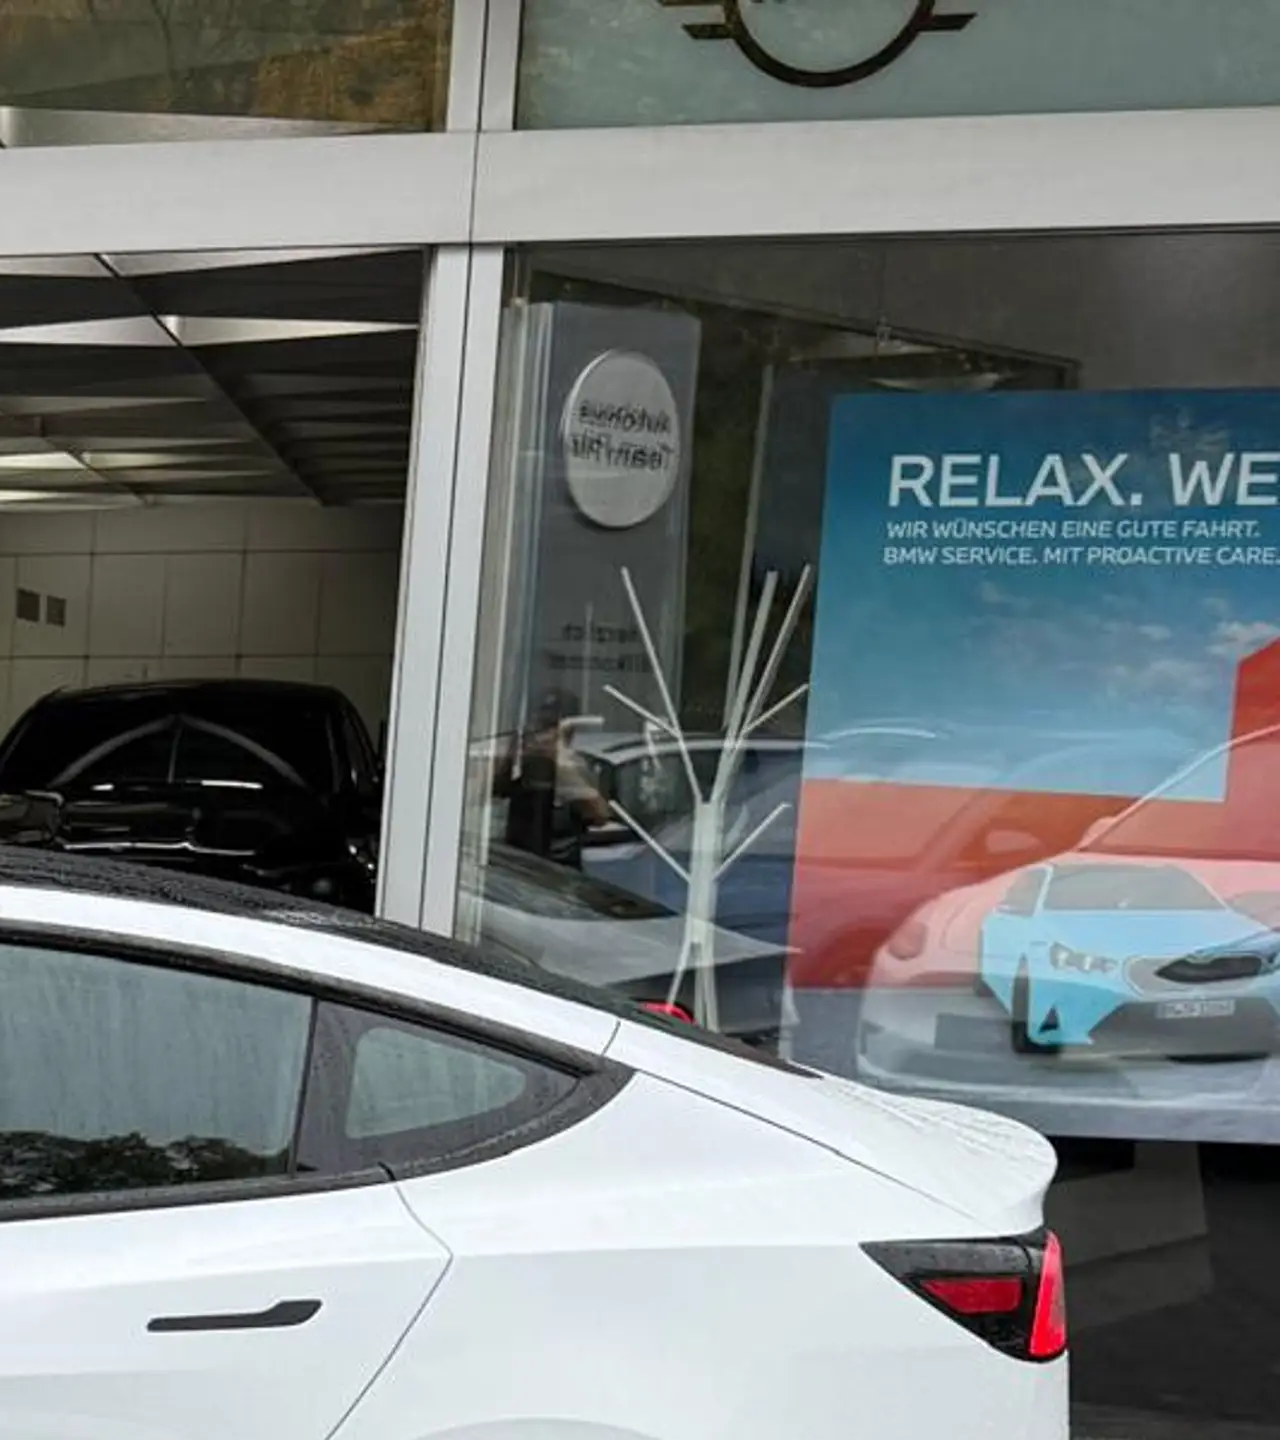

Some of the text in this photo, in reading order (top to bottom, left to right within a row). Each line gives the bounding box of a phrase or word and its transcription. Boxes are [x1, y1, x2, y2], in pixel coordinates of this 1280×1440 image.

[887, 452, 1280, 507] RELAX. WE
[886, 517, 1262, 540] WIR WÜNSCHEN EINE GUTE FAHRT.
[883, 546, 1280, 565] BMW SERVICE. MIT PROACTIVE CARE.
